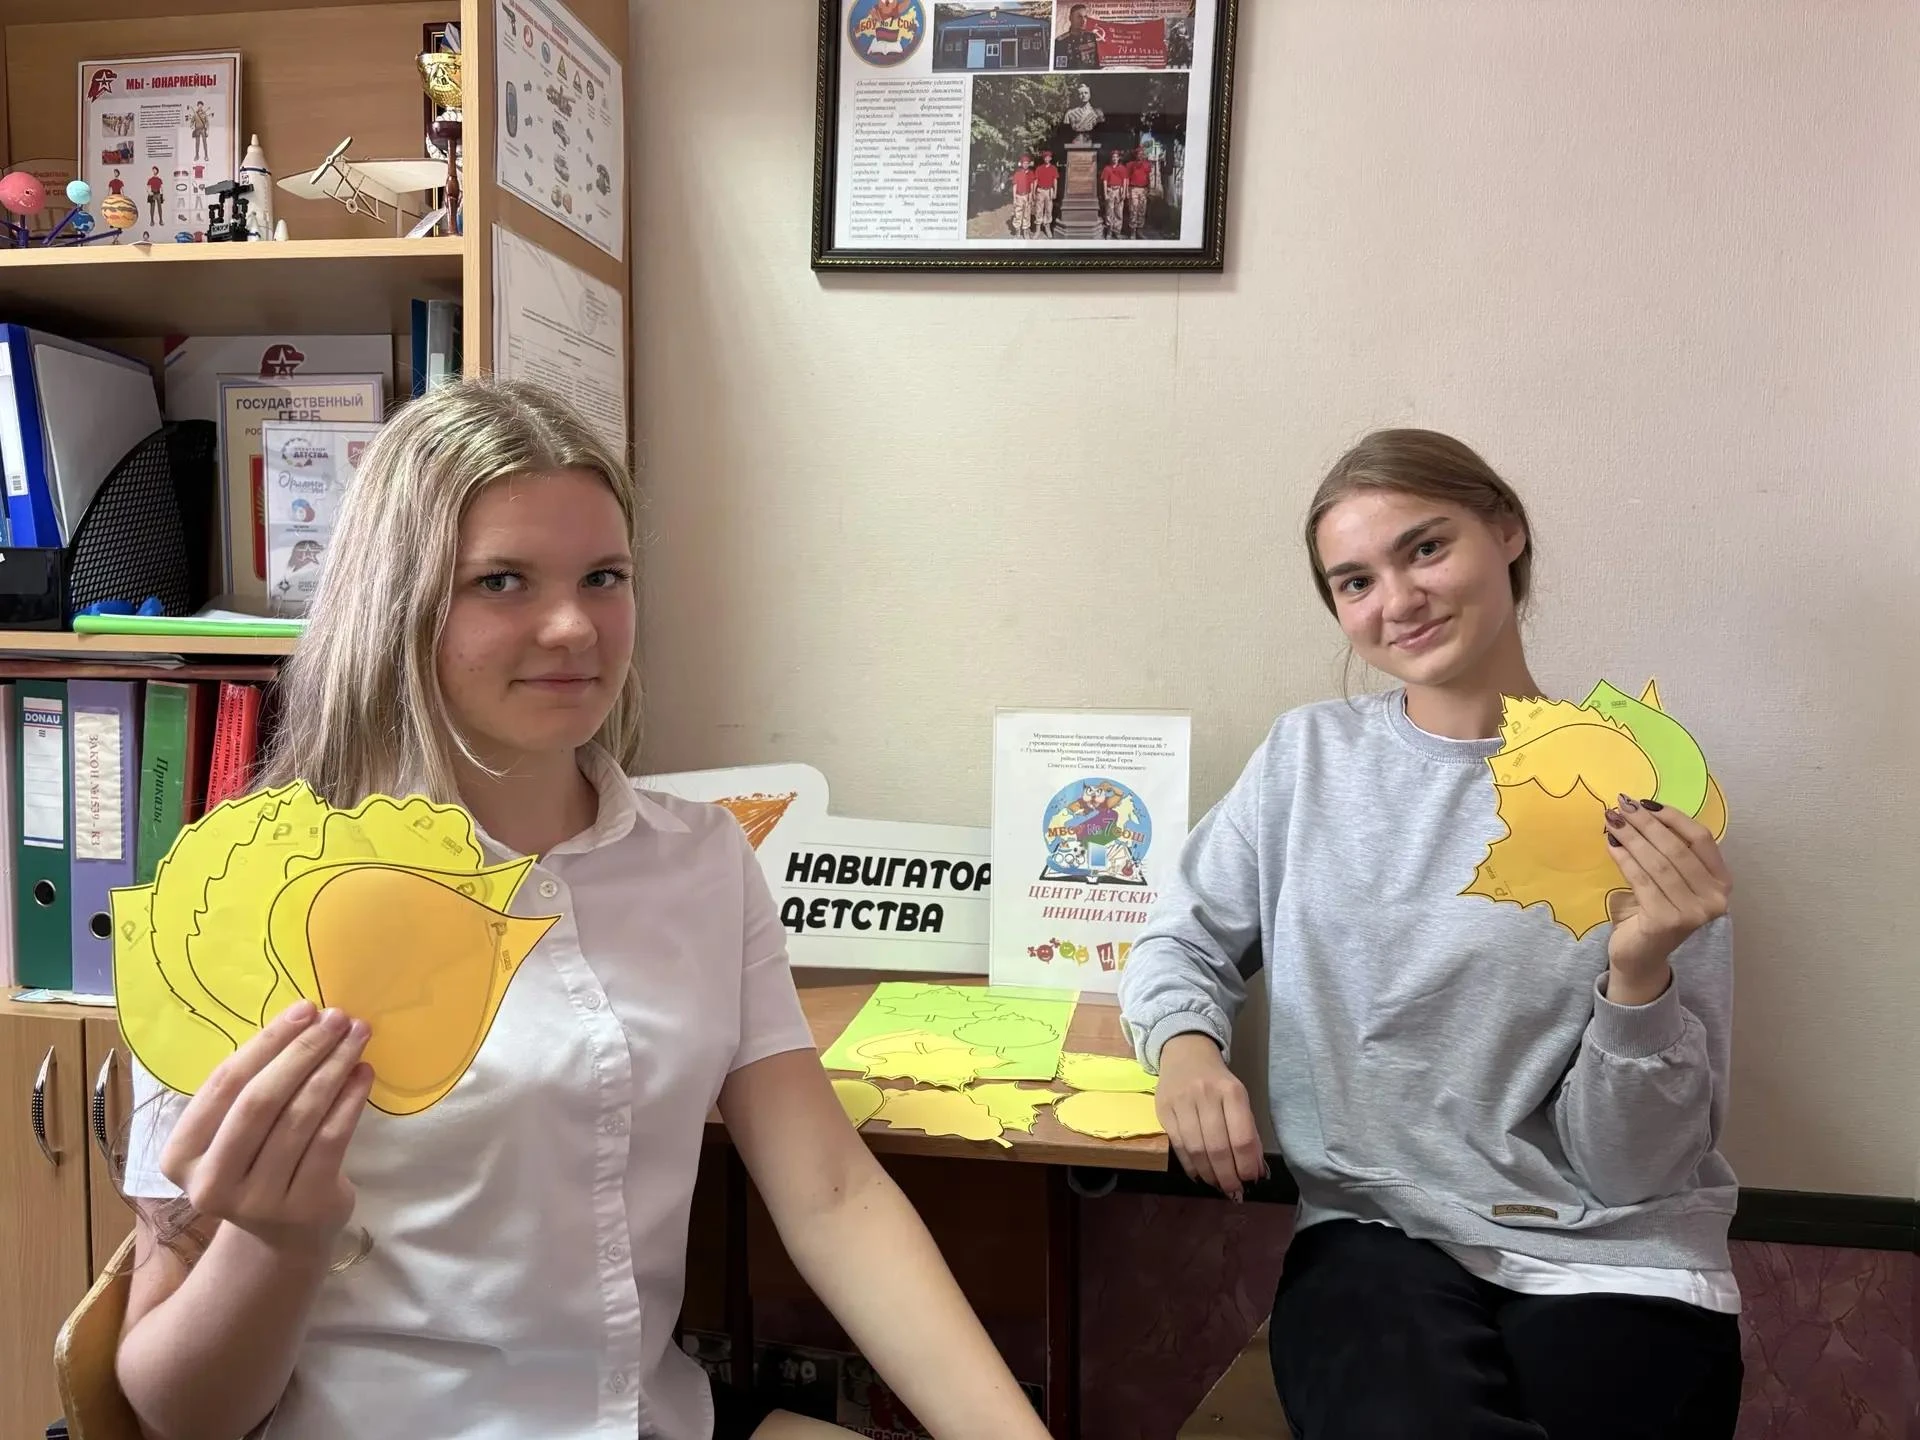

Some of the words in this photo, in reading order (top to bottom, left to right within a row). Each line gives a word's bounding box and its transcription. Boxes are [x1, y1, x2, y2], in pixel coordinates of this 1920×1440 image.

[126, 78, 144, 90] МЫ
[151, 74, 217, 90] ЮНАРМЕЙЦЫ
[236, 393, 364, 411] ГОСУДАРСТВЕННЫЙ
[279, 410, 321, 422] ГЕРБ
[25, 712, 61, 725] DONAU
[89, 735, 100, 779] ЗАКОН
[153, 756, 169, 823] Приказы
[1103, 817, 1115, 837] 7
[785, 852, 992, 891] НАВИГАТОР
[1028, 885, 1083, 900] ЦЕНТР
[780, 896, 944, 934] ДЕТСТВА
[1043, 906, 1148, 924] ИНИЦИАТИВ
